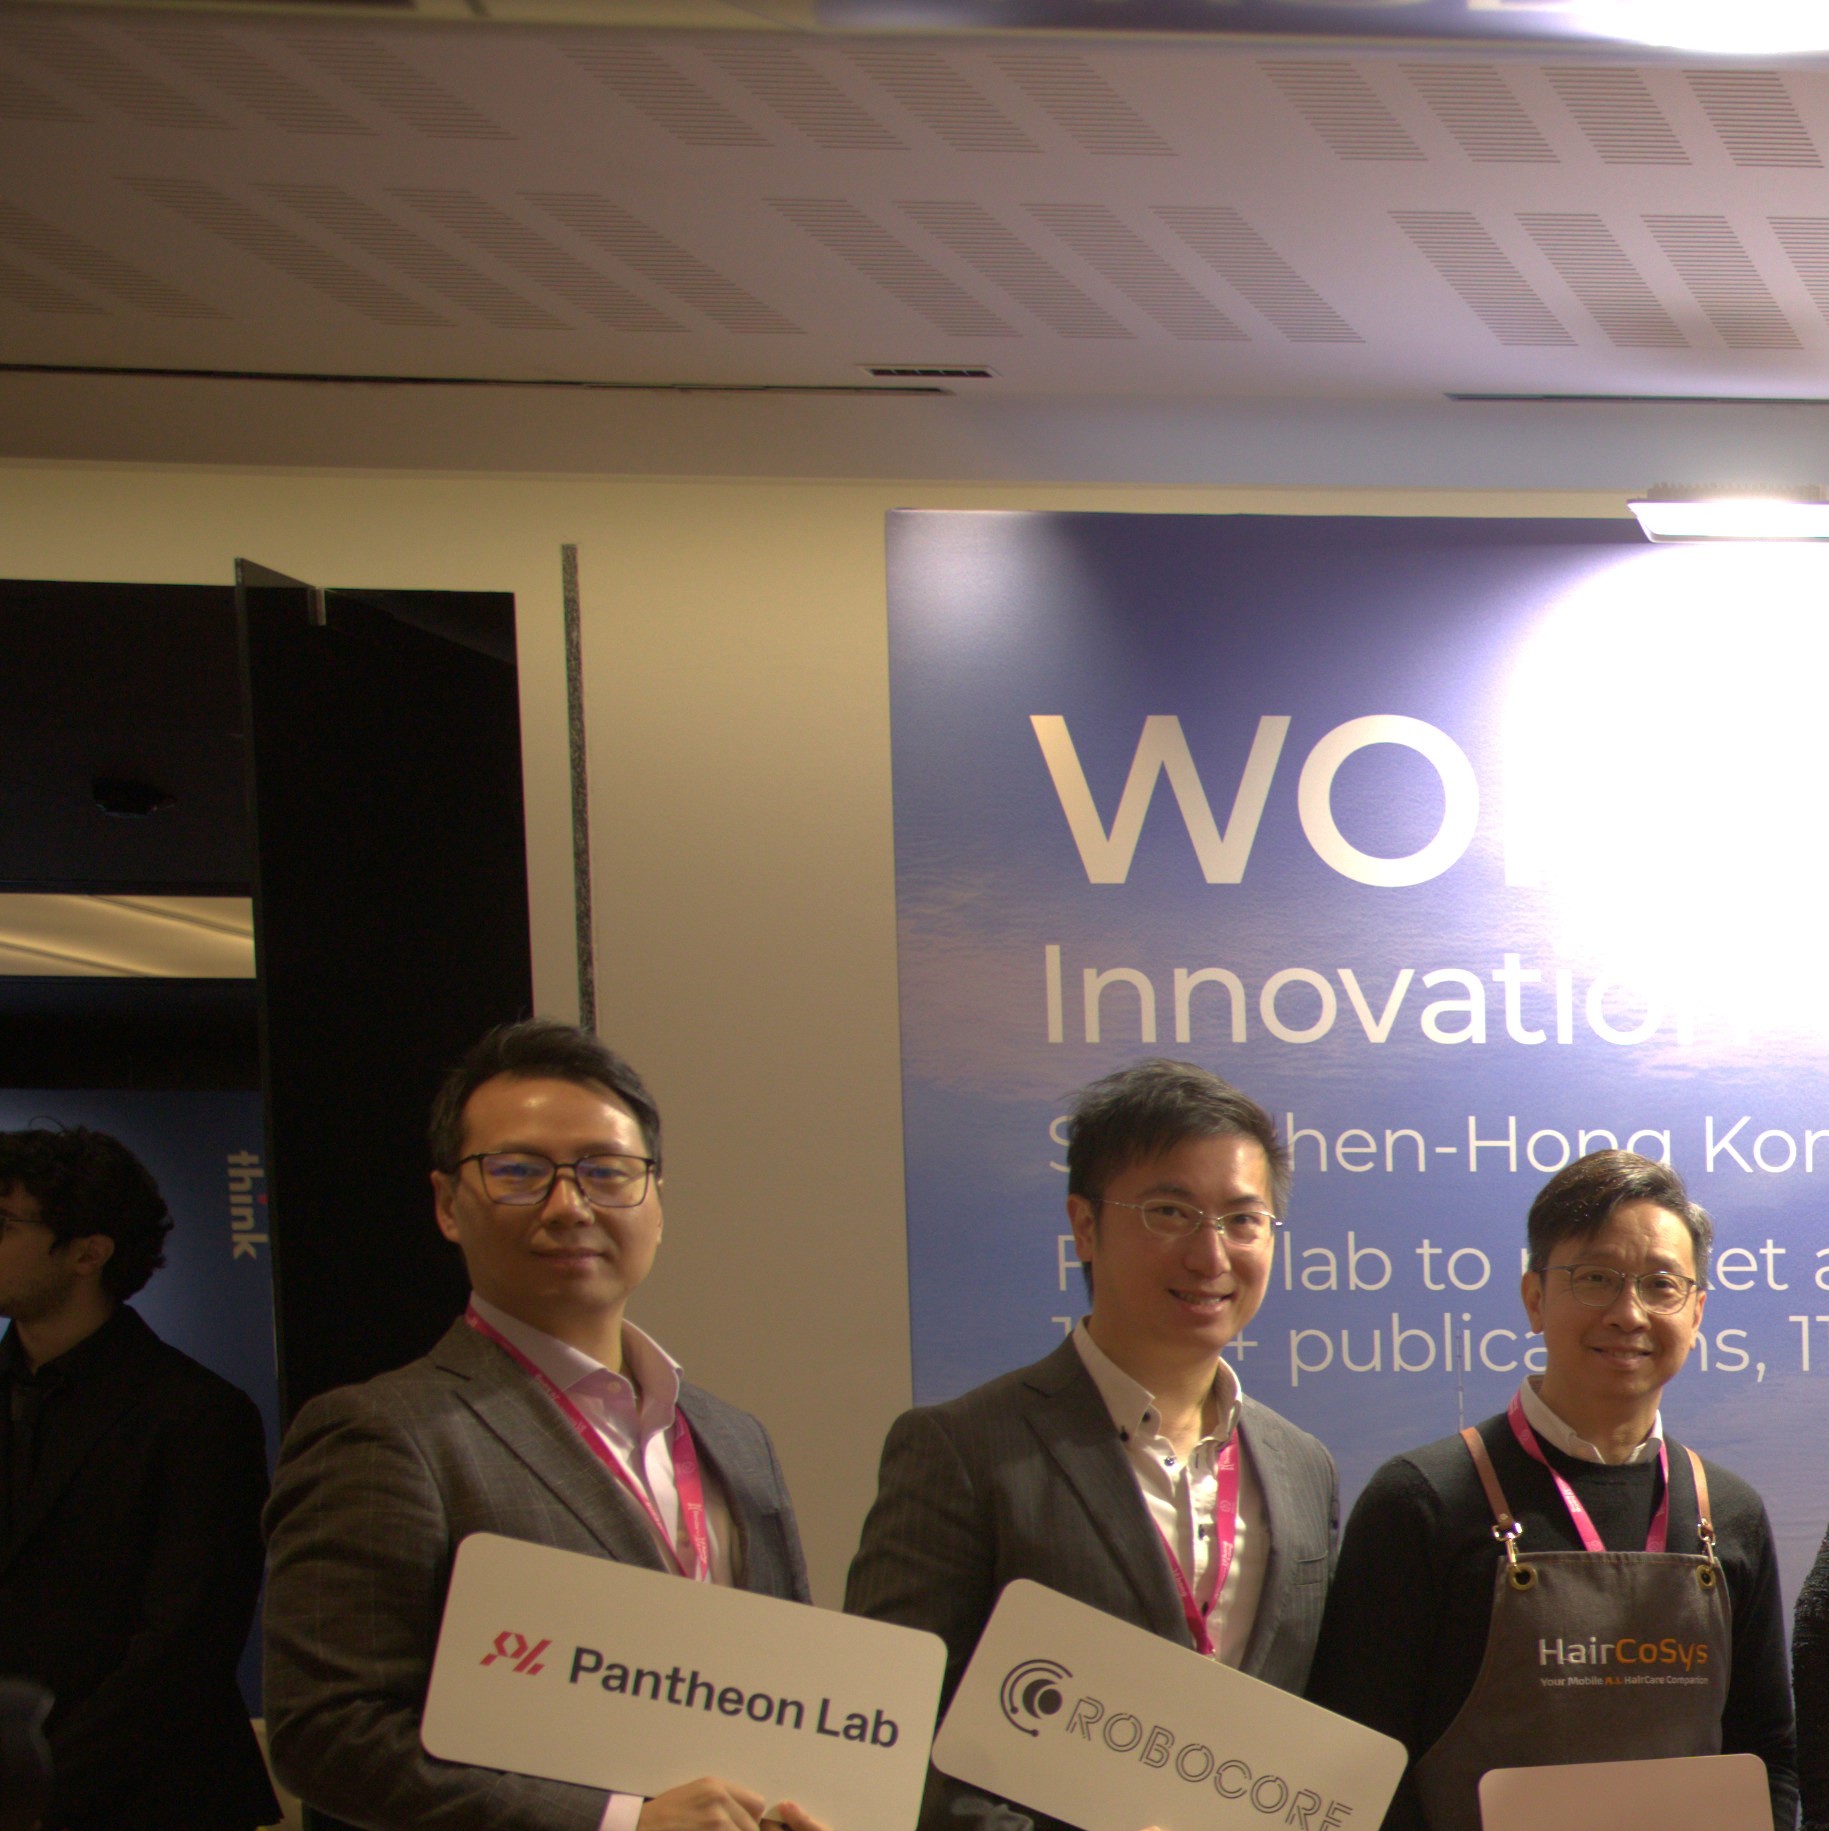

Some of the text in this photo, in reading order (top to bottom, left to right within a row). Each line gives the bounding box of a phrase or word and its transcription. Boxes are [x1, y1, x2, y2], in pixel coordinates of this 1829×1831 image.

[1029, 714, 1500, 888] WO
[227, 1150, 268, 1260] think
[1284, 1231, 1393, 1291] lab
[1417, 1239, 1491, 1291] to
[1290, 1312, 1766, 1386] publicas,
[1538, 1636, 1709, 1672] HairCoSys
[1540, 1677, 1566, 1687] Your
[1567, 1676, 1603, 1686] Mobile
[568, 1645, 901, 1750] Pantheon Lab
